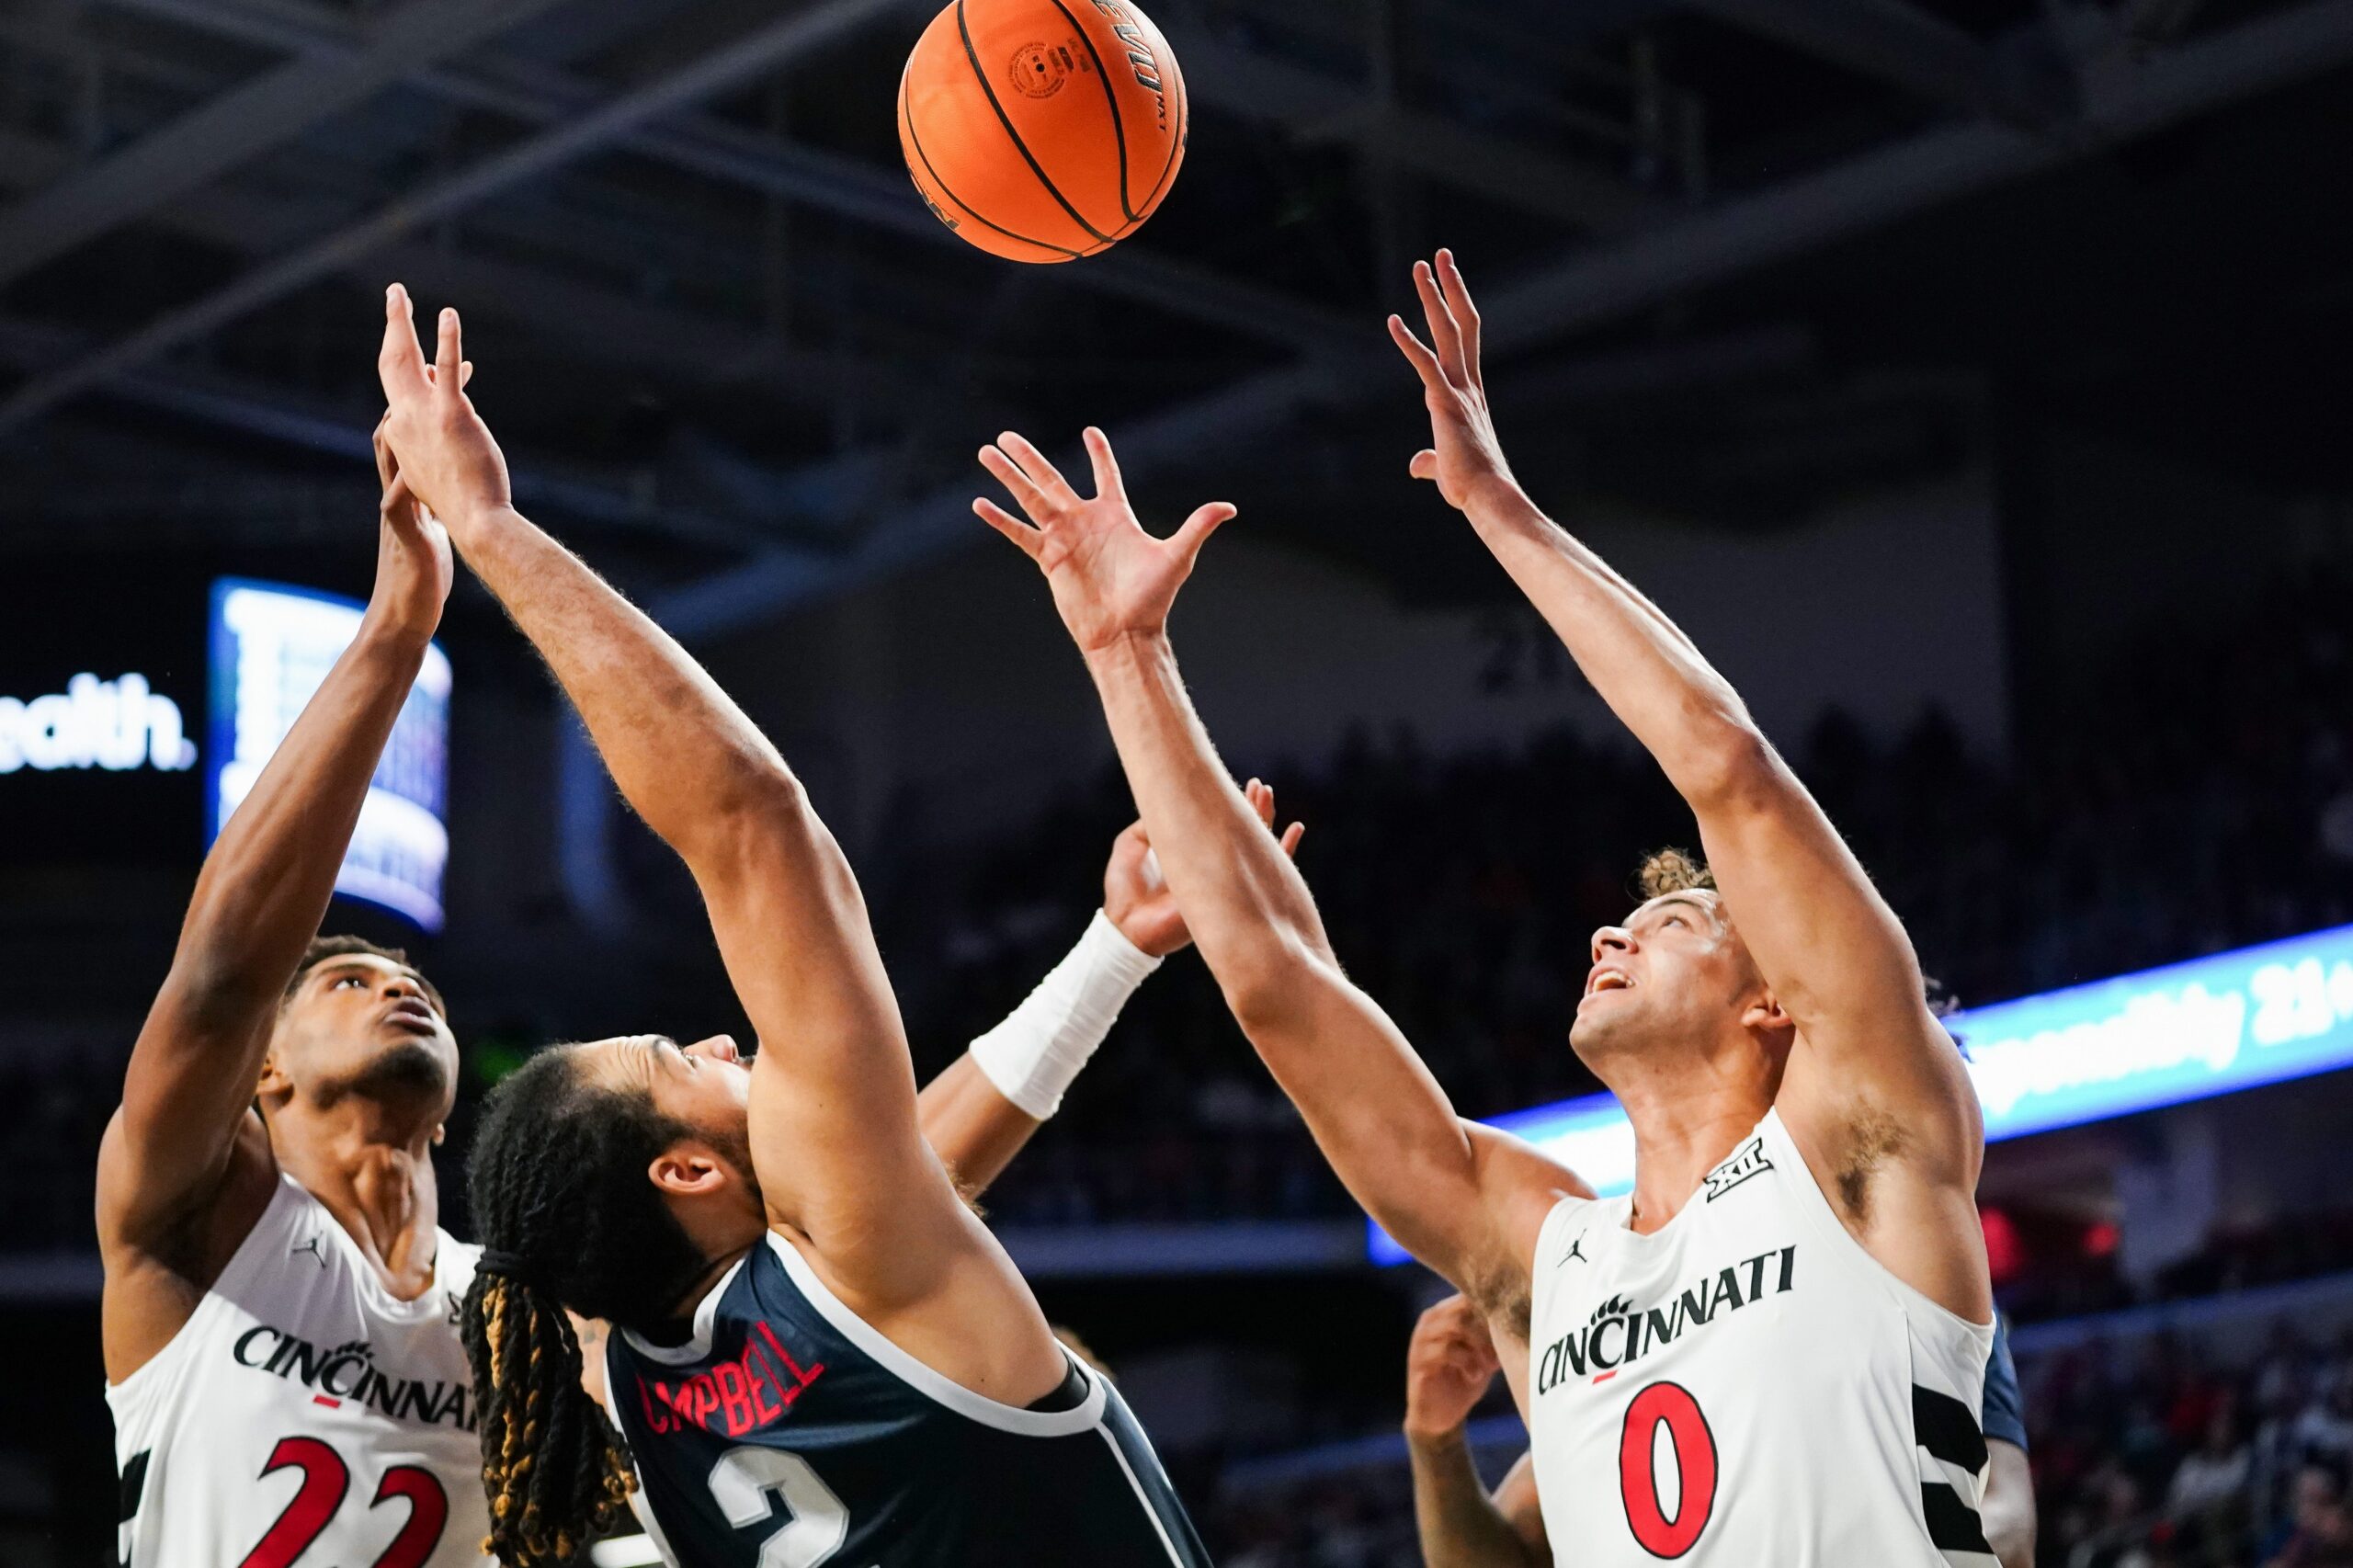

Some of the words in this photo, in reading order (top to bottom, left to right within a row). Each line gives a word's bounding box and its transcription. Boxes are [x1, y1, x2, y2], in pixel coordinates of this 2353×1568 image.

[1154, 94, 1168, 133] NXT
[1538, 1244, 1797, 1397] CINCINNATI
[237, 1436, 449, 1568] 22
[707, 1445, 851, 1568] 2
[1619, 1381, 1719, 1561] 0
